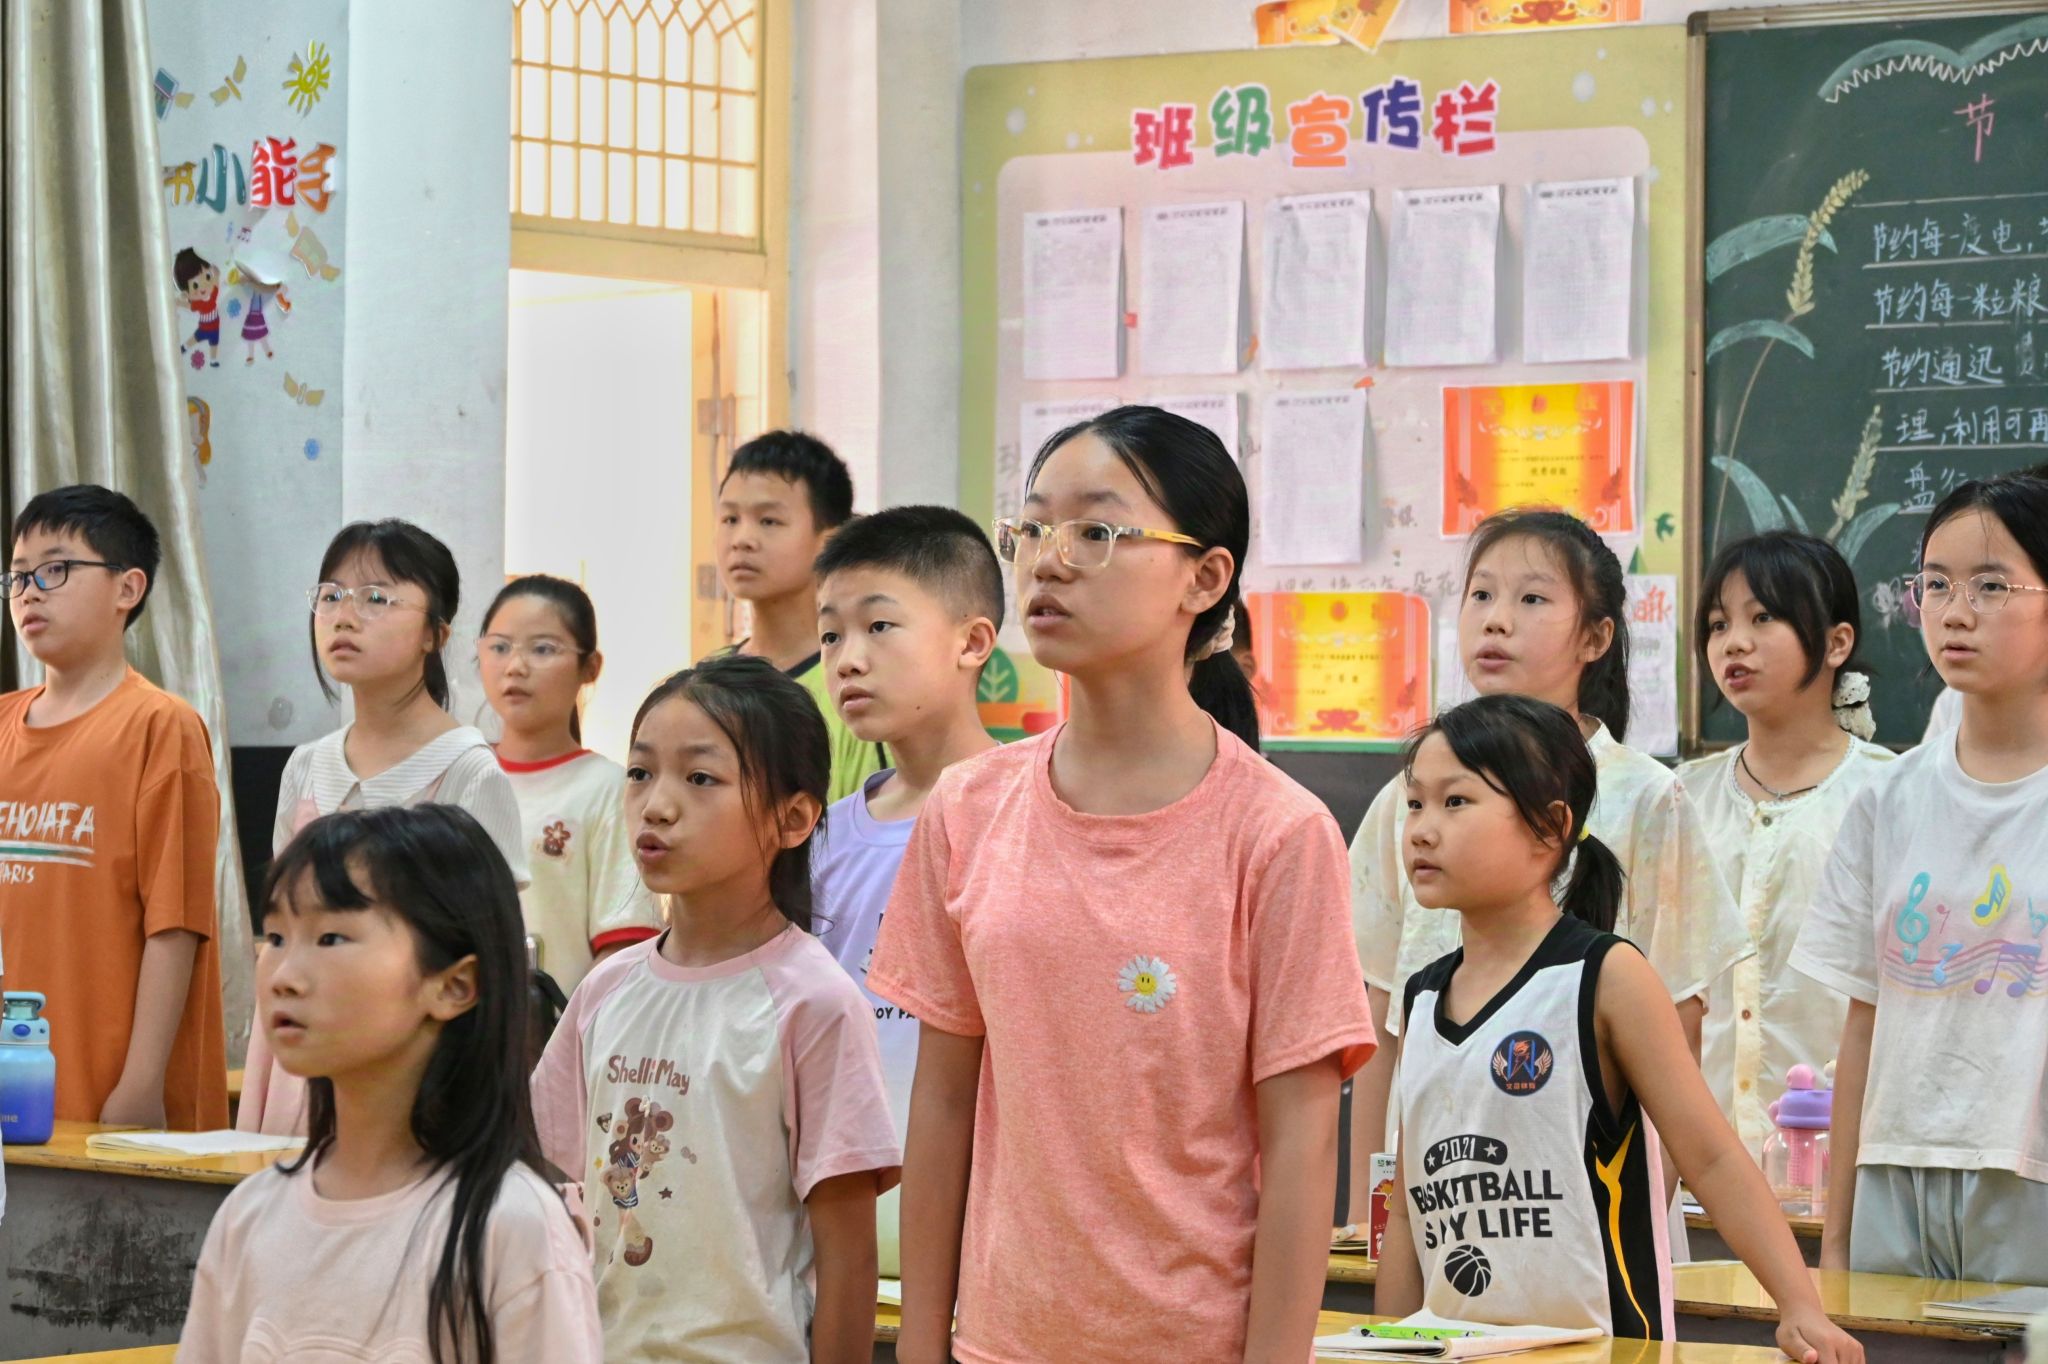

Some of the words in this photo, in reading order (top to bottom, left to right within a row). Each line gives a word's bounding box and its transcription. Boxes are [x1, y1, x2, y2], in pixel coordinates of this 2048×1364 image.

[1133, 79, 1497, 170] 班级宣传栏
[1952, 92, 1995, 163] 节
[1438, 1136, 1476, 1165] 2021
[1477, 1207, 1553, 1238] LIFE
